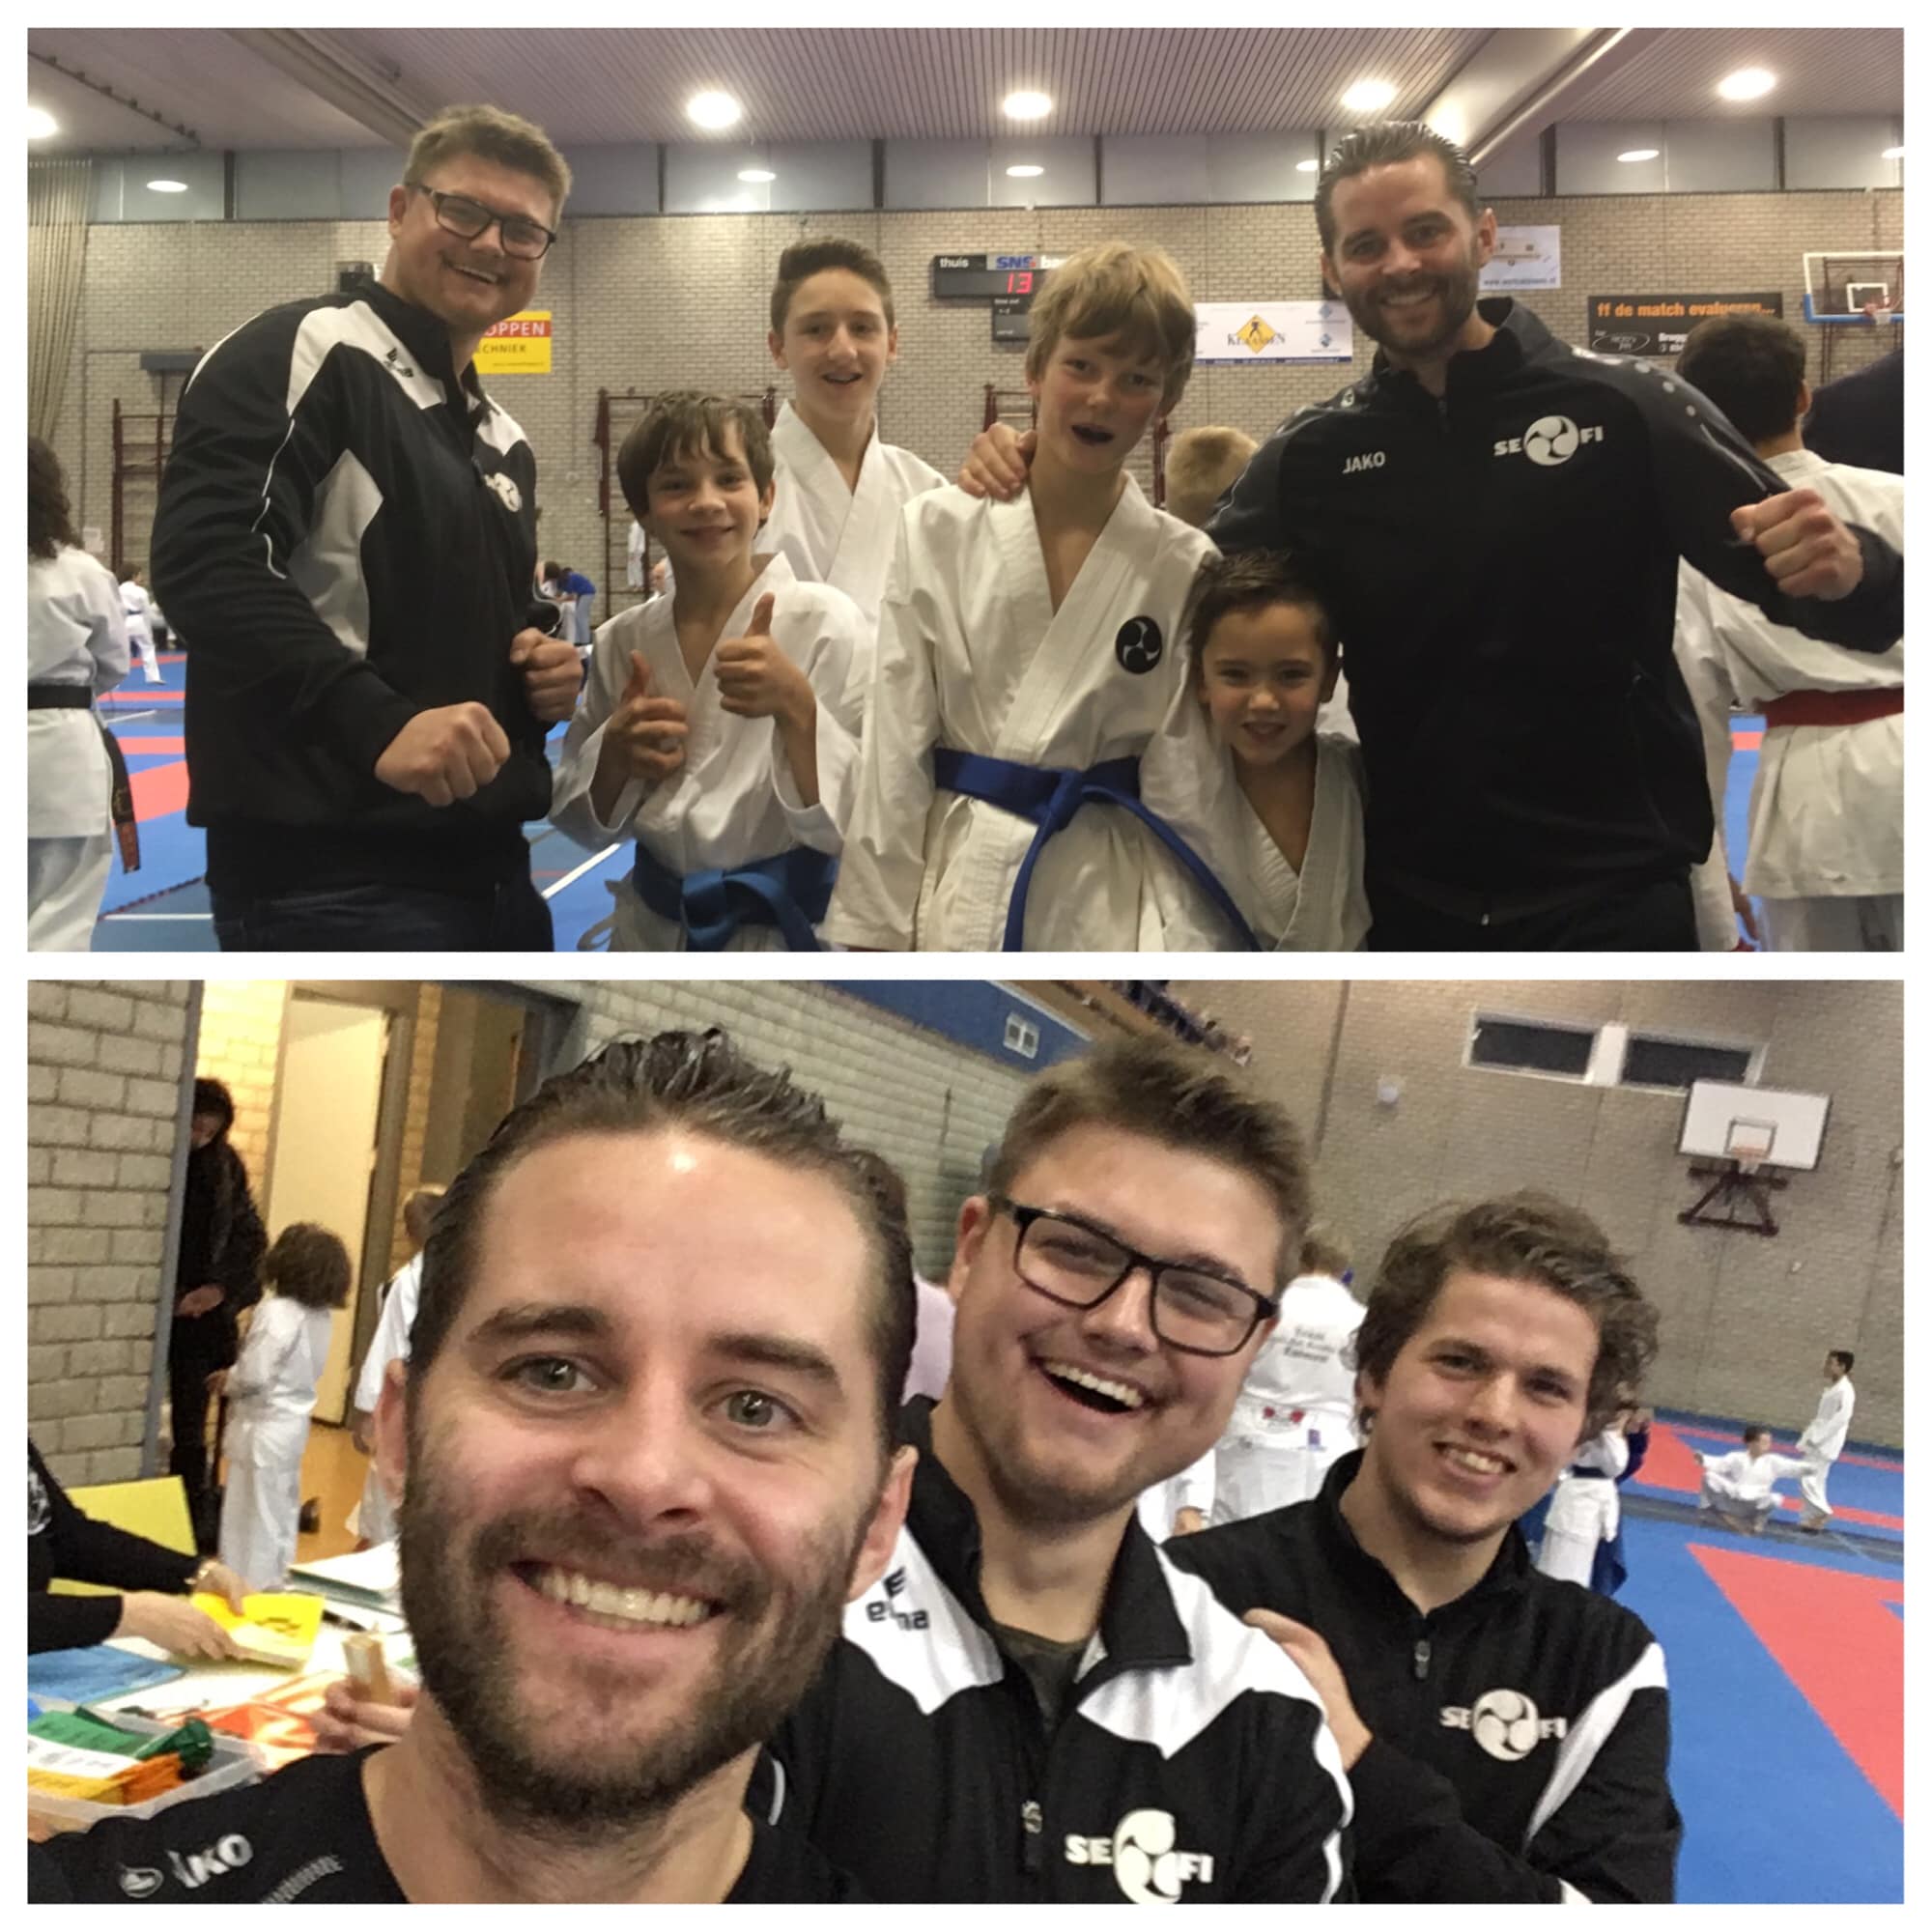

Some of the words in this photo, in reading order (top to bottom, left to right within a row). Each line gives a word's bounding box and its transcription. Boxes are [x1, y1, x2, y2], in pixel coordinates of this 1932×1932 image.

[940, 256, 970, 269] thuis
[1007, 271, 1033, 294] 13
[1598, 302, 1611, 318] ff
[1615, 302, 1633, 317] de
[1637, 301, 1685, 317] match
[1493, 437, 1523, 456] SE
[1578, 425, 1605, 444] FI
[1342, 451, 1386, 474] JAKO
[1439, 1705, 1472, 1730] SE
[1538, 1717, 1567, 1739] FI
[1065, 1833, 1114, 1865] SE
[1176, 1852, 1214, 1884] FI
